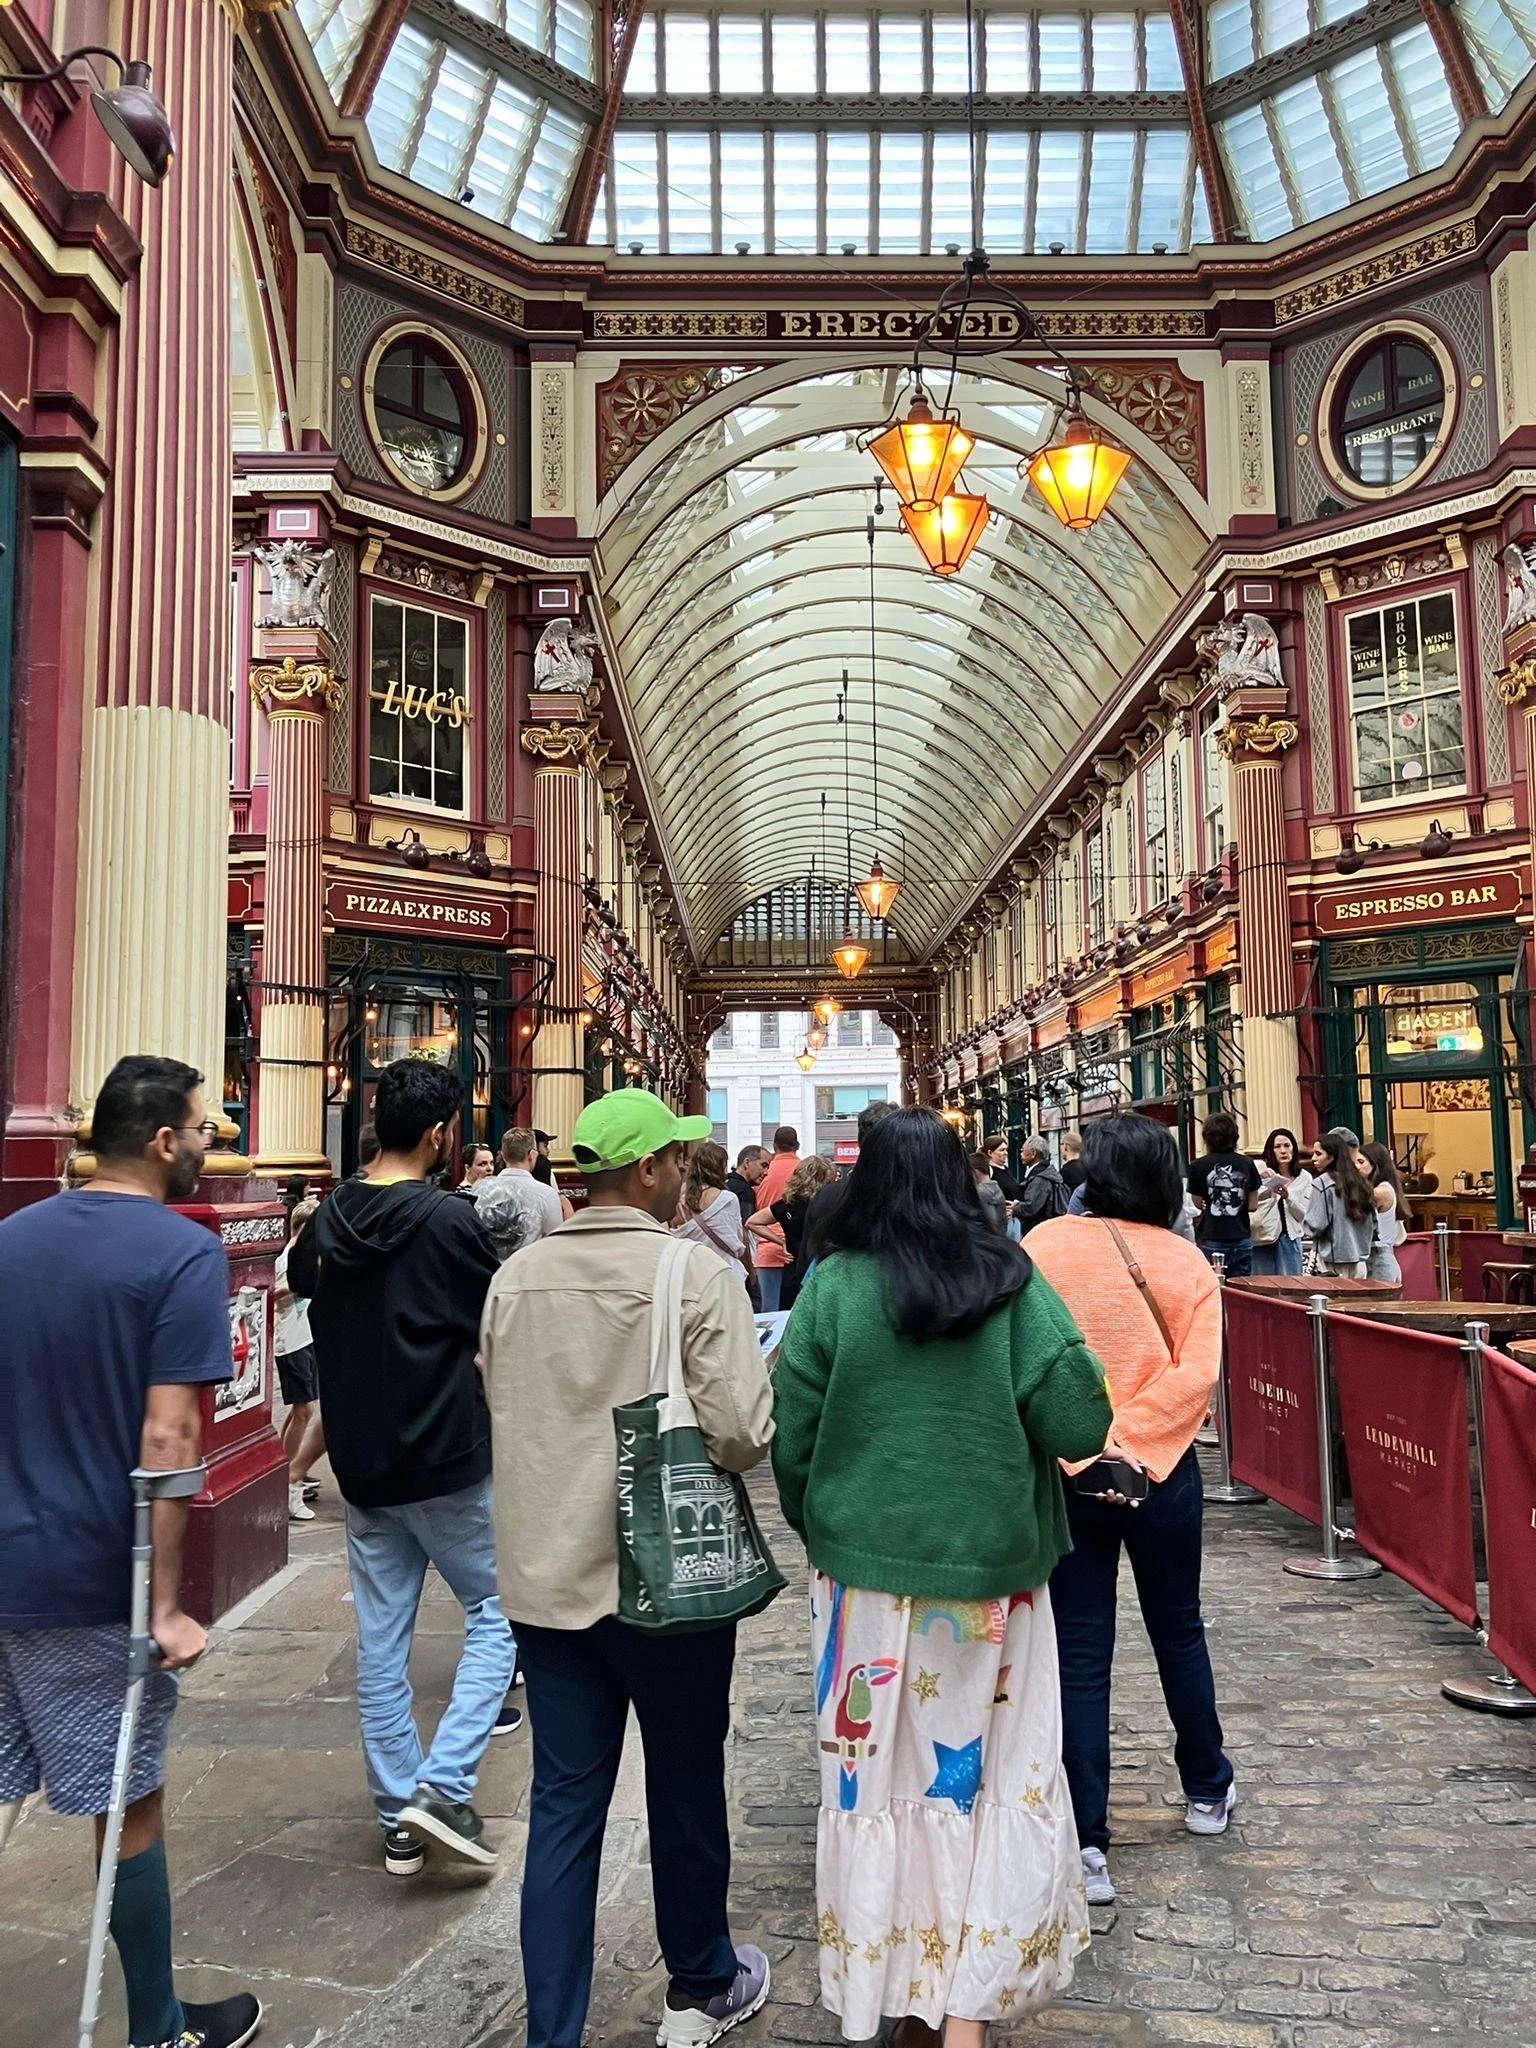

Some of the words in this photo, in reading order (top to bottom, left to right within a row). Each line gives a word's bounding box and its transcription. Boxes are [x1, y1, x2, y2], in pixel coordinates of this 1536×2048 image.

[781, 312, 1020, 337] ERECTED
[1350, 390, 1386, 409] WINE
[1408, 373, 1434, 390] BAR
[1352, 411, 1436, 448] RESTAURANT
[1353, 648, 1381, 662] WINE
[1395, 610, 1409, 693] BROKERS
[1424, 631, 1453, 646] WINE
[1428, 642, 1450, 655] BAR
[1357, 659, 1378, 671] BAR
[380, 680, 466, 729] LUC'S
[345, 894, 492, 927] PIZZAEXPRESS
[1335, 892, 1444, 920] ESPRESSO
[1450, 885, 1498, 906] BAR
[1365, 1425, 1437, 1467] LEADENHALL
[617, 1429, 637, 1518] DAUNT
